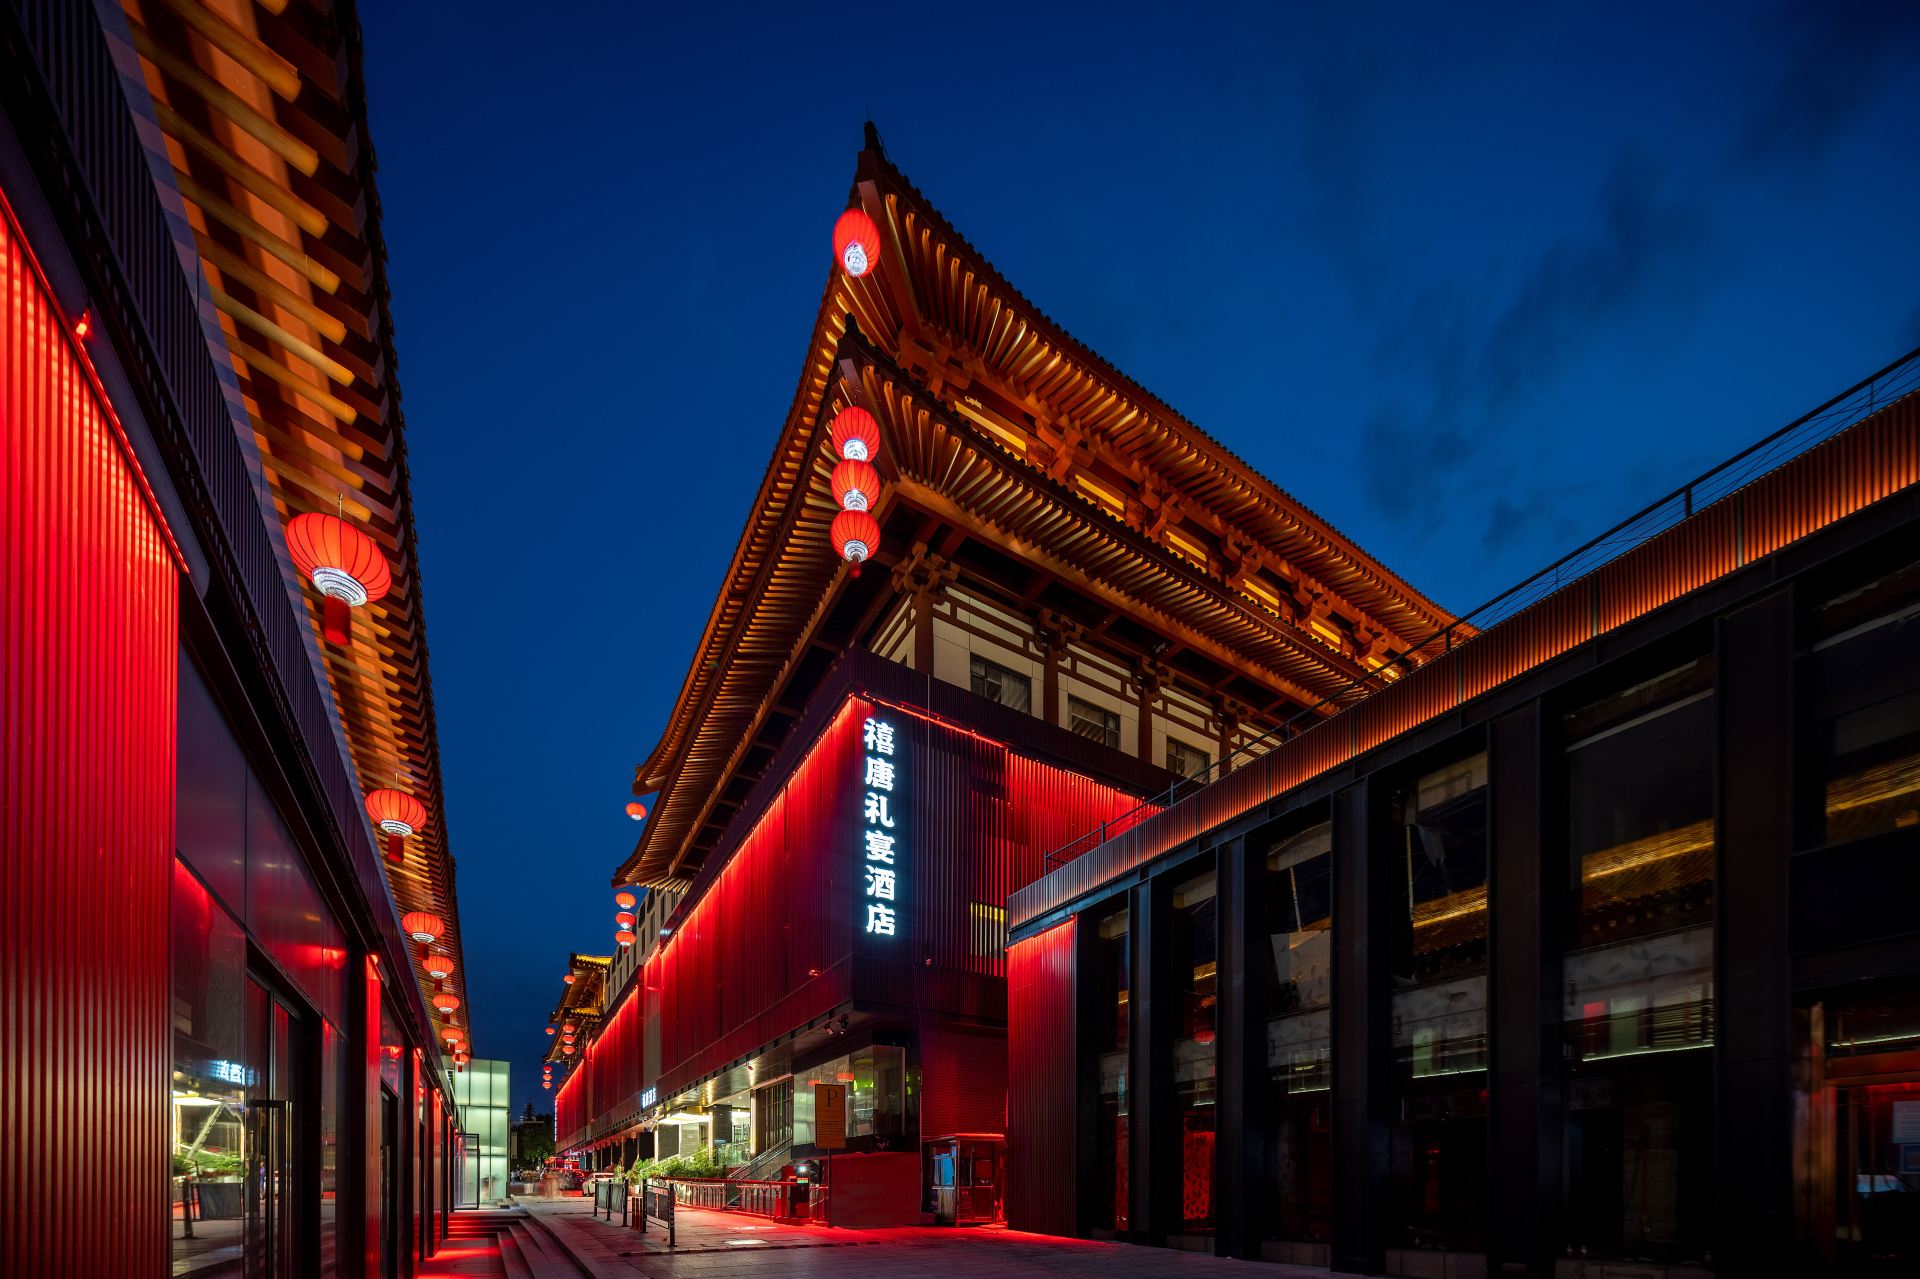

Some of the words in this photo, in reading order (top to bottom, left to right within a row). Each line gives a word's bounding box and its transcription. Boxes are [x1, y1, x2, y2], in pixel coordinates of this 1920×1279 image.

[864, 718, 896, 936] 禧唐礼宴酒店
[827, 1088, 838, 1107] P
